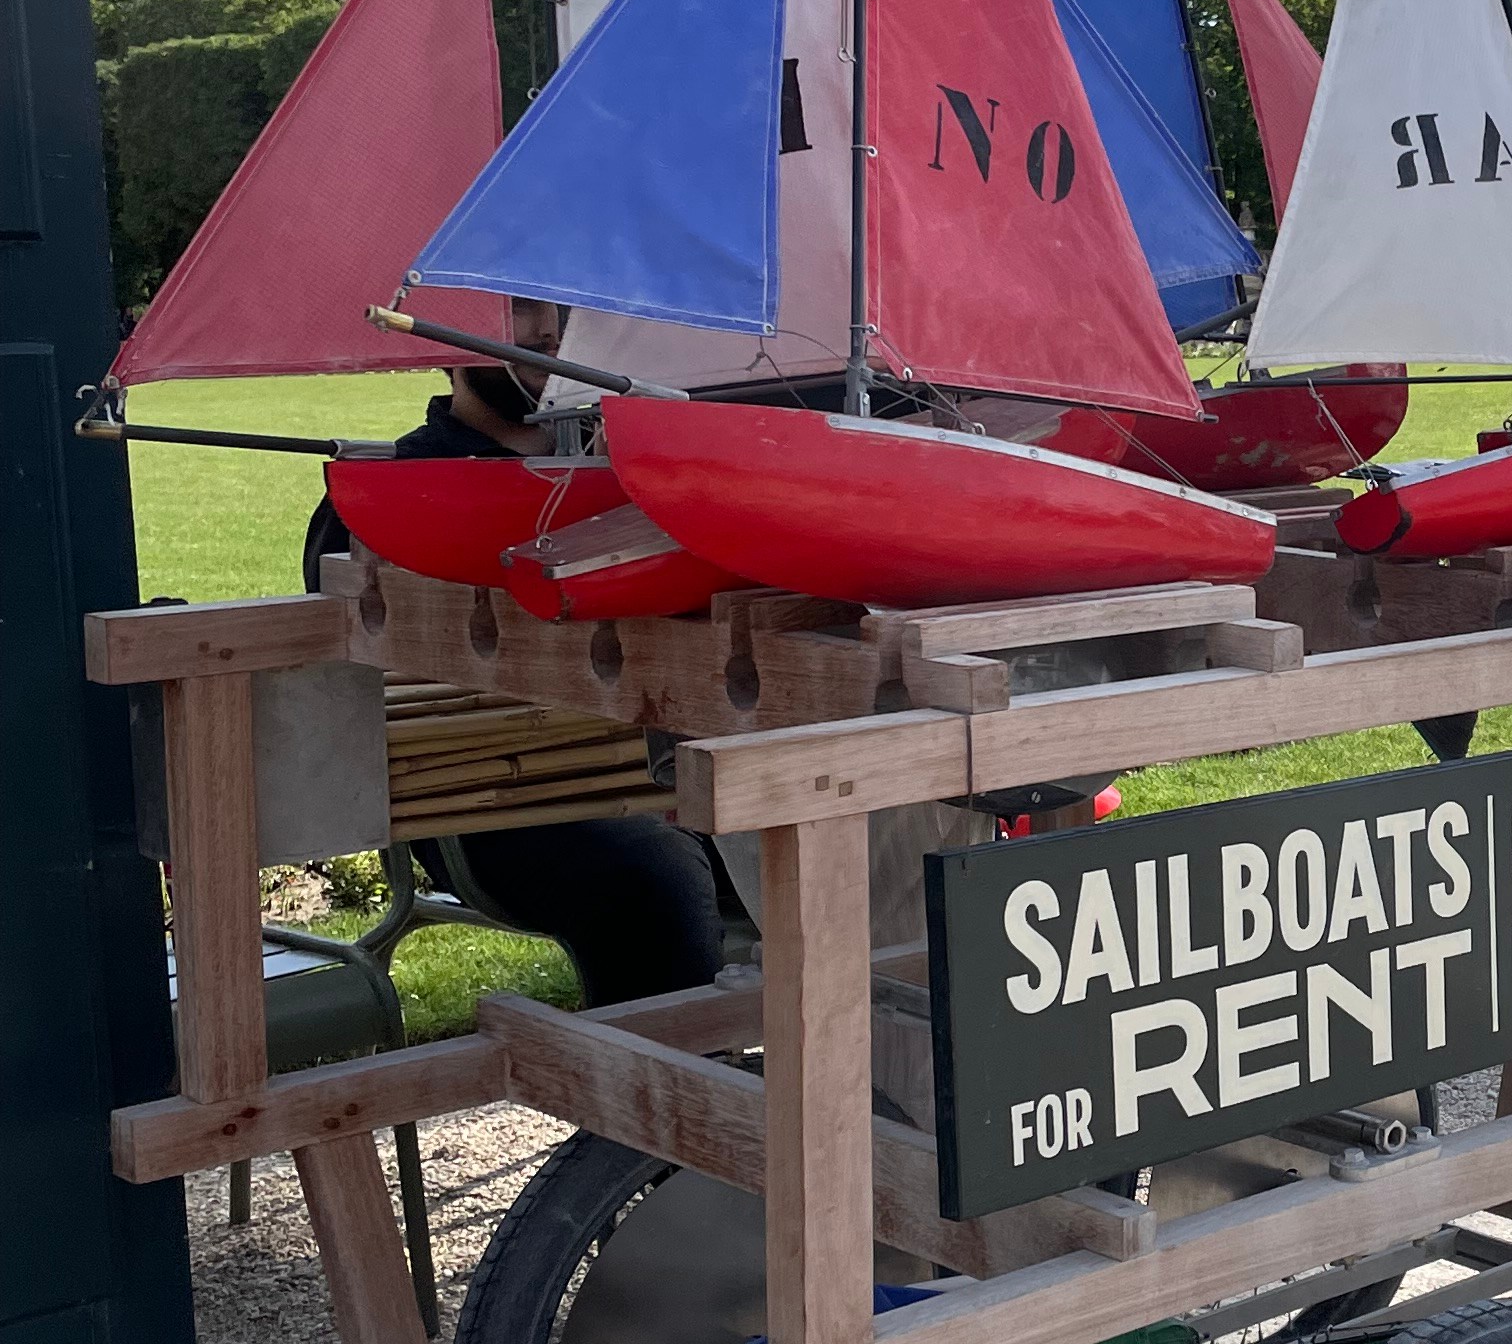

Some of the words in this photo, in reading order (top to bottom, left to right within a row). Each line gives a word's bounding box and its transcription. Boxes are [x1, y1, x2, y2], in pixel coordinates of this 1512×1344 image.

[1005, 801, 1471, 1013] SAILBOATS
[1011, 1088, 1093, 1166] FOR
[1111, 929, 1471, 1136] RENT
